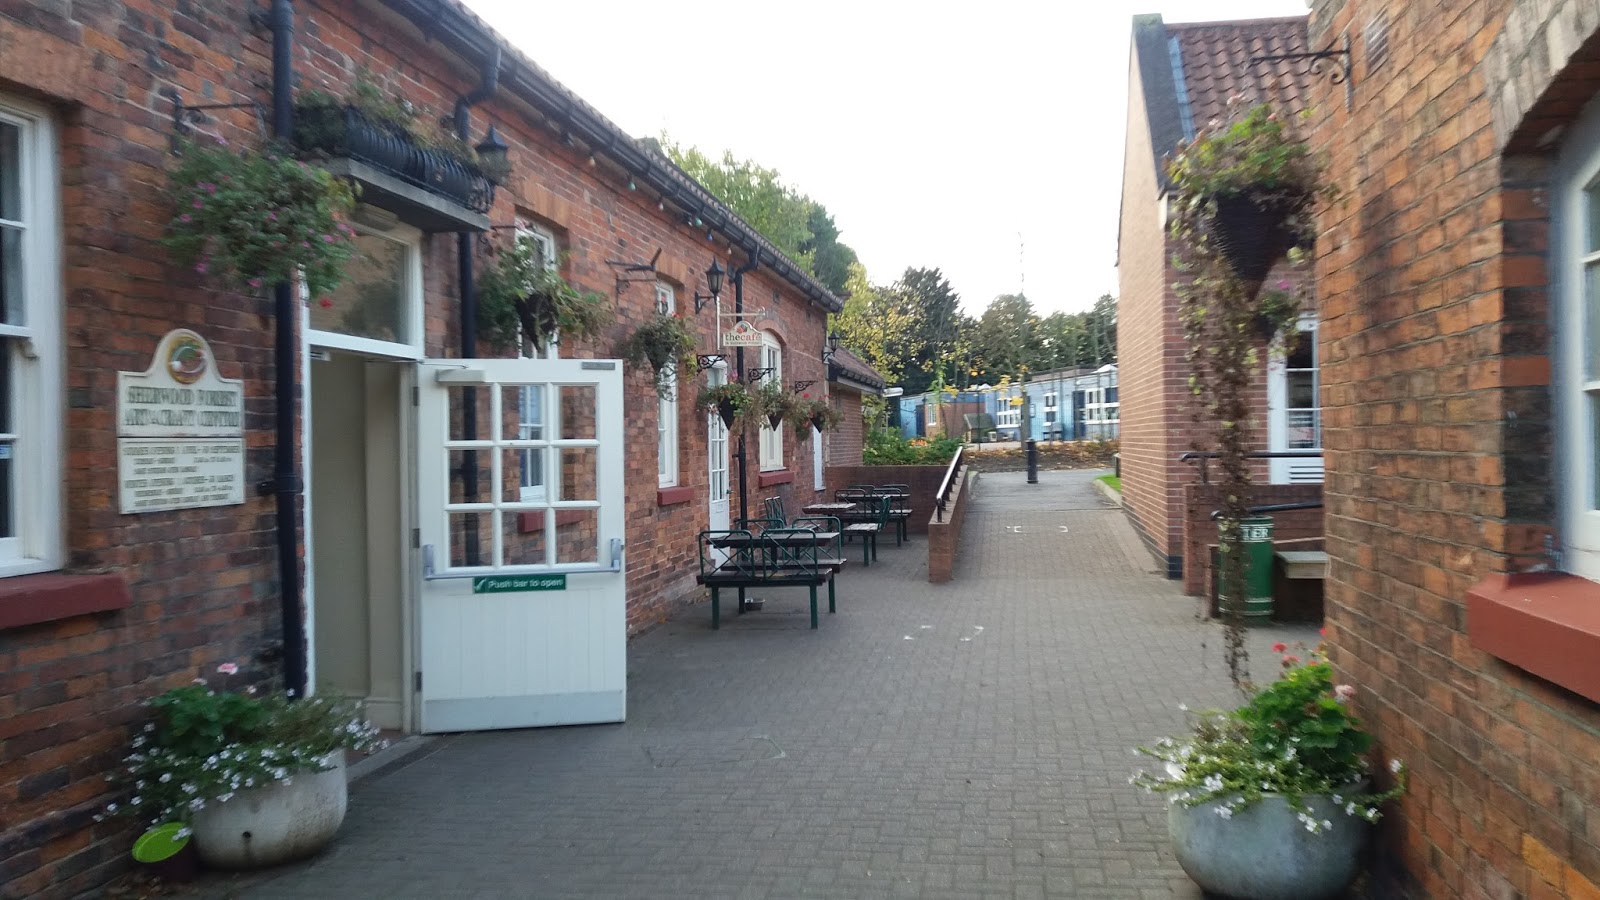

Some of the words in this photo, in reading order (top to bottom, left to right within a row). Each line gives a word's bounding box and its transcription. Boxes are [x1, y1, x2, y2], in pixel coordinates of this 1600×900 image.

[488, 580, 512, 589] Push
[513, 579, 528, 588] bar
[530, 579, 539, 587] to
[540, 579, 564, 588] open
